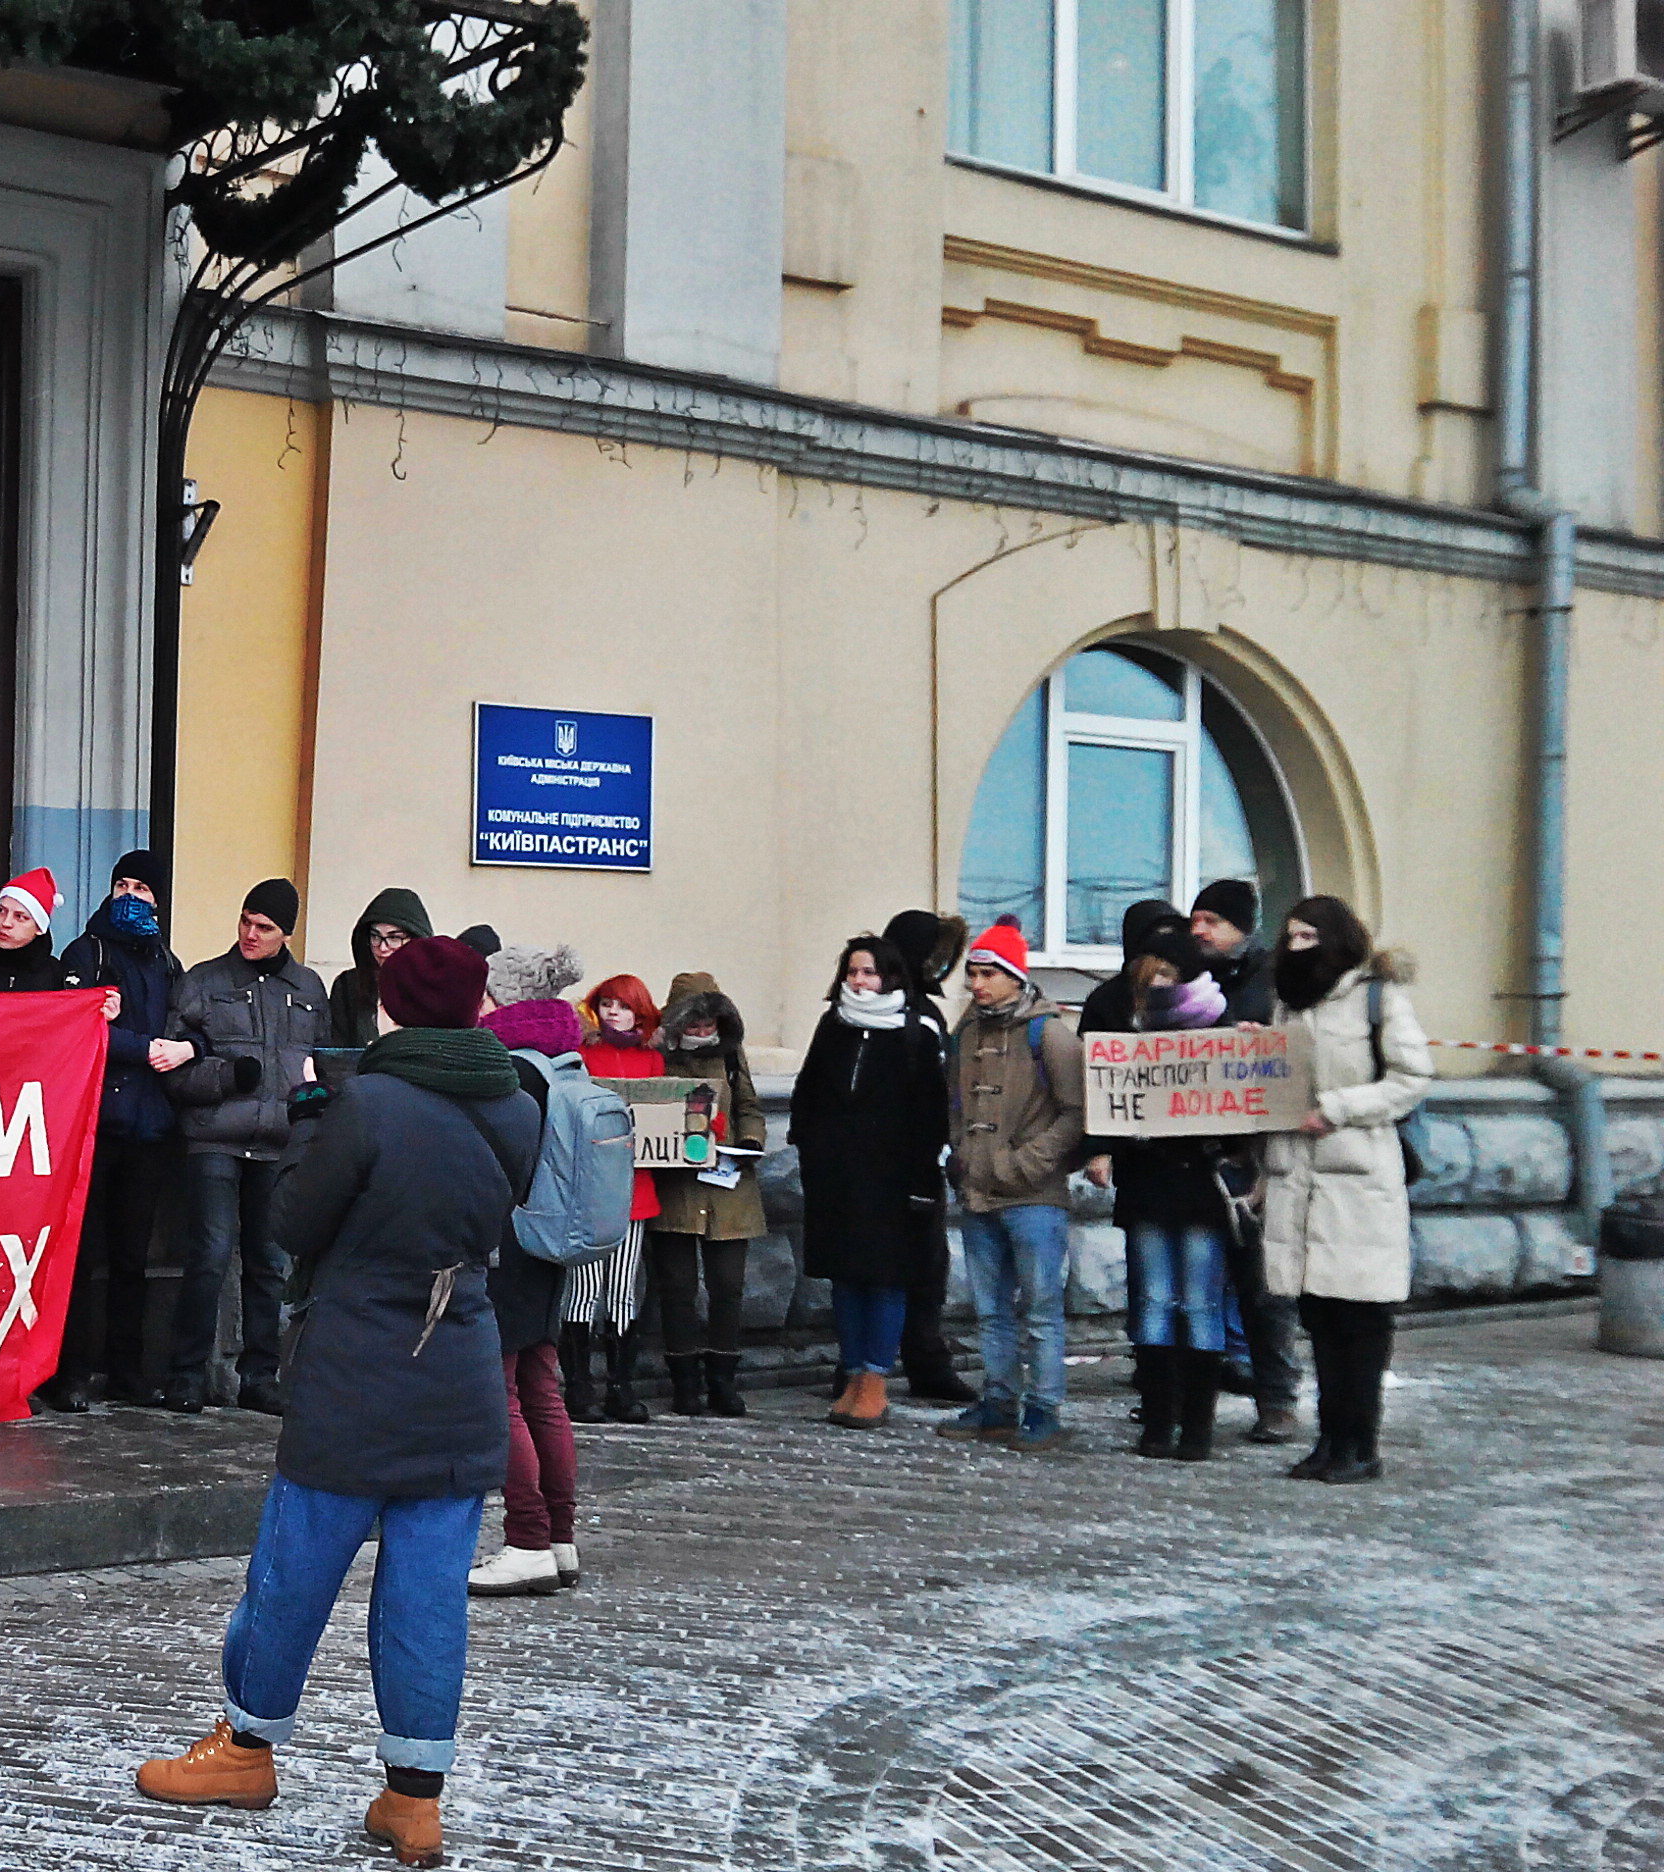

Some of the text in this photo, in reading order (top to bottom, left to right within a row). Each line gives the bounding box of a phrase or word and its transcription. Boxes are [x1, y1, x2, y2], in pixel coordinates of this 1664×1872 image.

[497, 754, 632, 775] КИЇВСЬКА МІСЬКА ДЕРЖАВНА
[488, 809, 641, 830] КОМУНАЛЬНЕ ПІДПРИЄМСТВО
[1090, 1032, 1287, 1063] АВАРІЙНИЙ
[1090, 1060, 1211, 1089] ТРАНСПОРТ
[1108, 1092, 1146, 1121] НЕ
